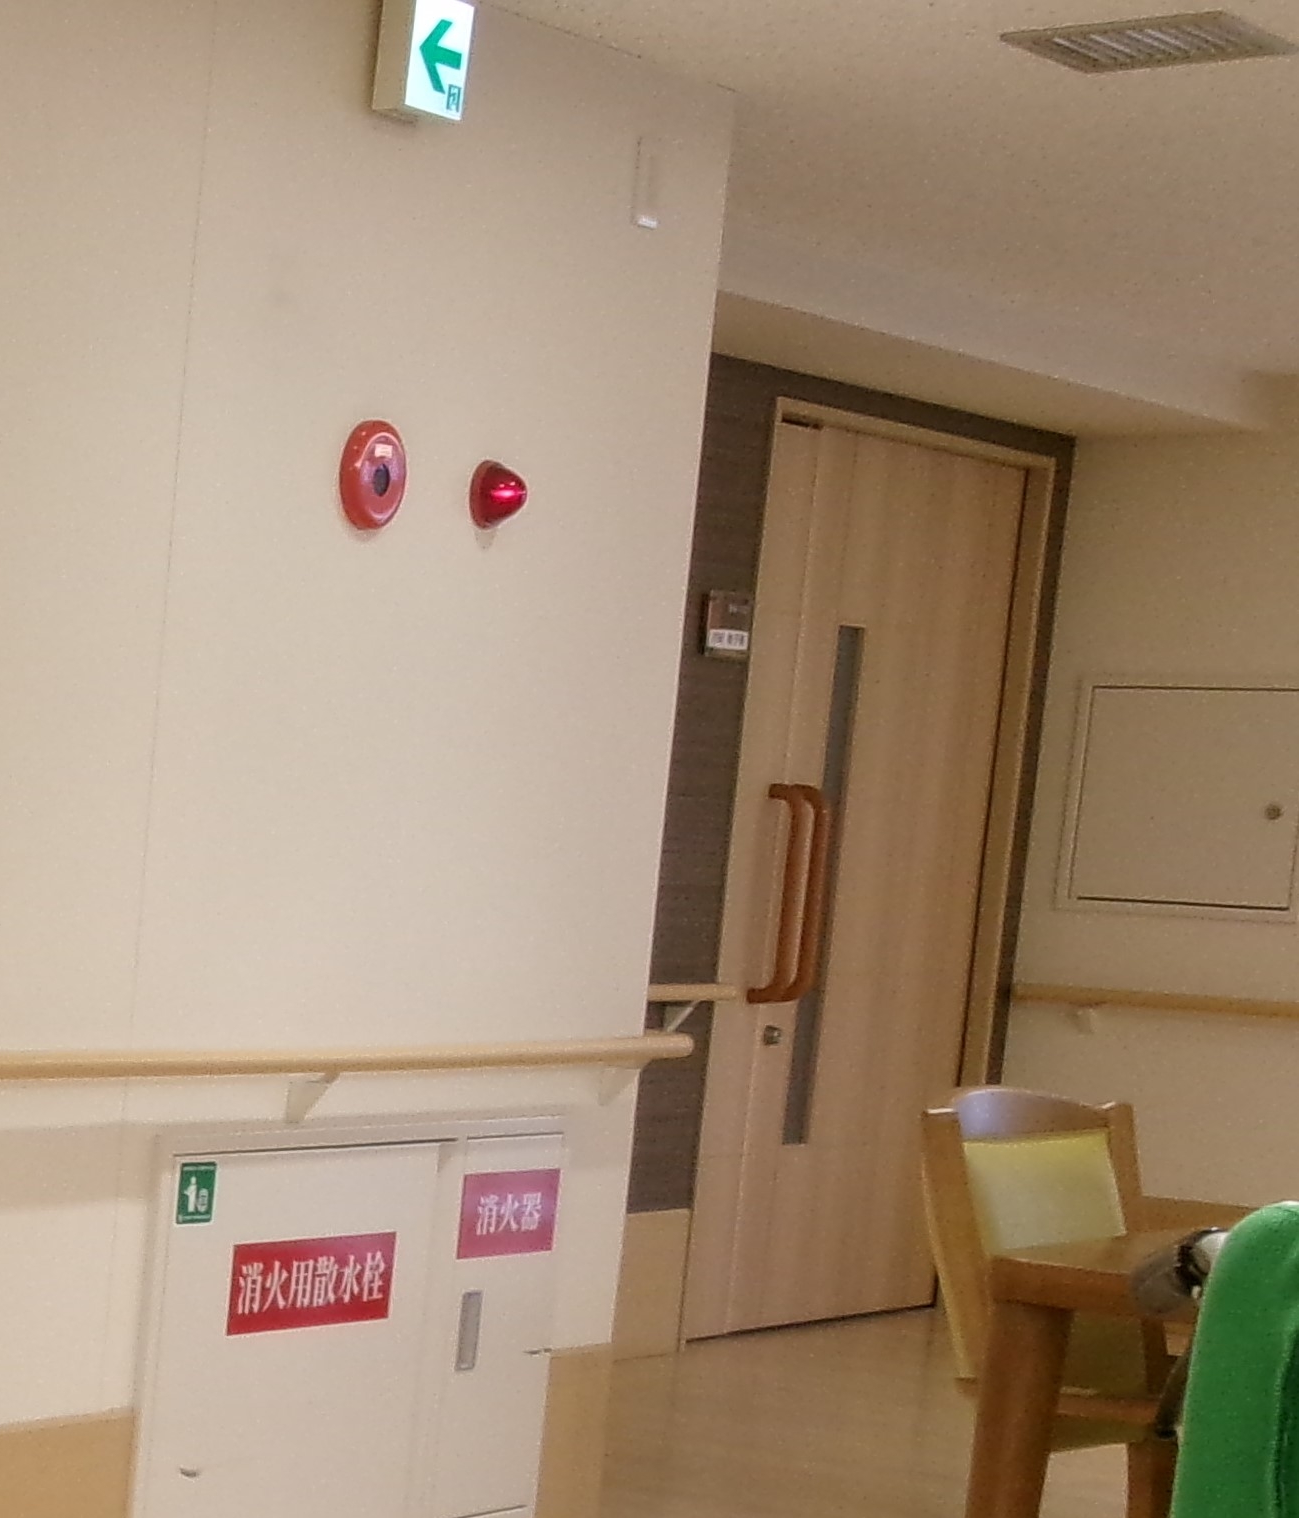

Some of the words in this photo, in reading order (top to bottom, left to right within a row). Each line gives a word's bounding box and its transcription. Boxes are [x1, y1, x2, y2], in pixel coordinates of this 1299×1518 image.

[475, 1192, 542, 1236] 消火器
[237, 1251, 386, 1315] 消火用散水栓
